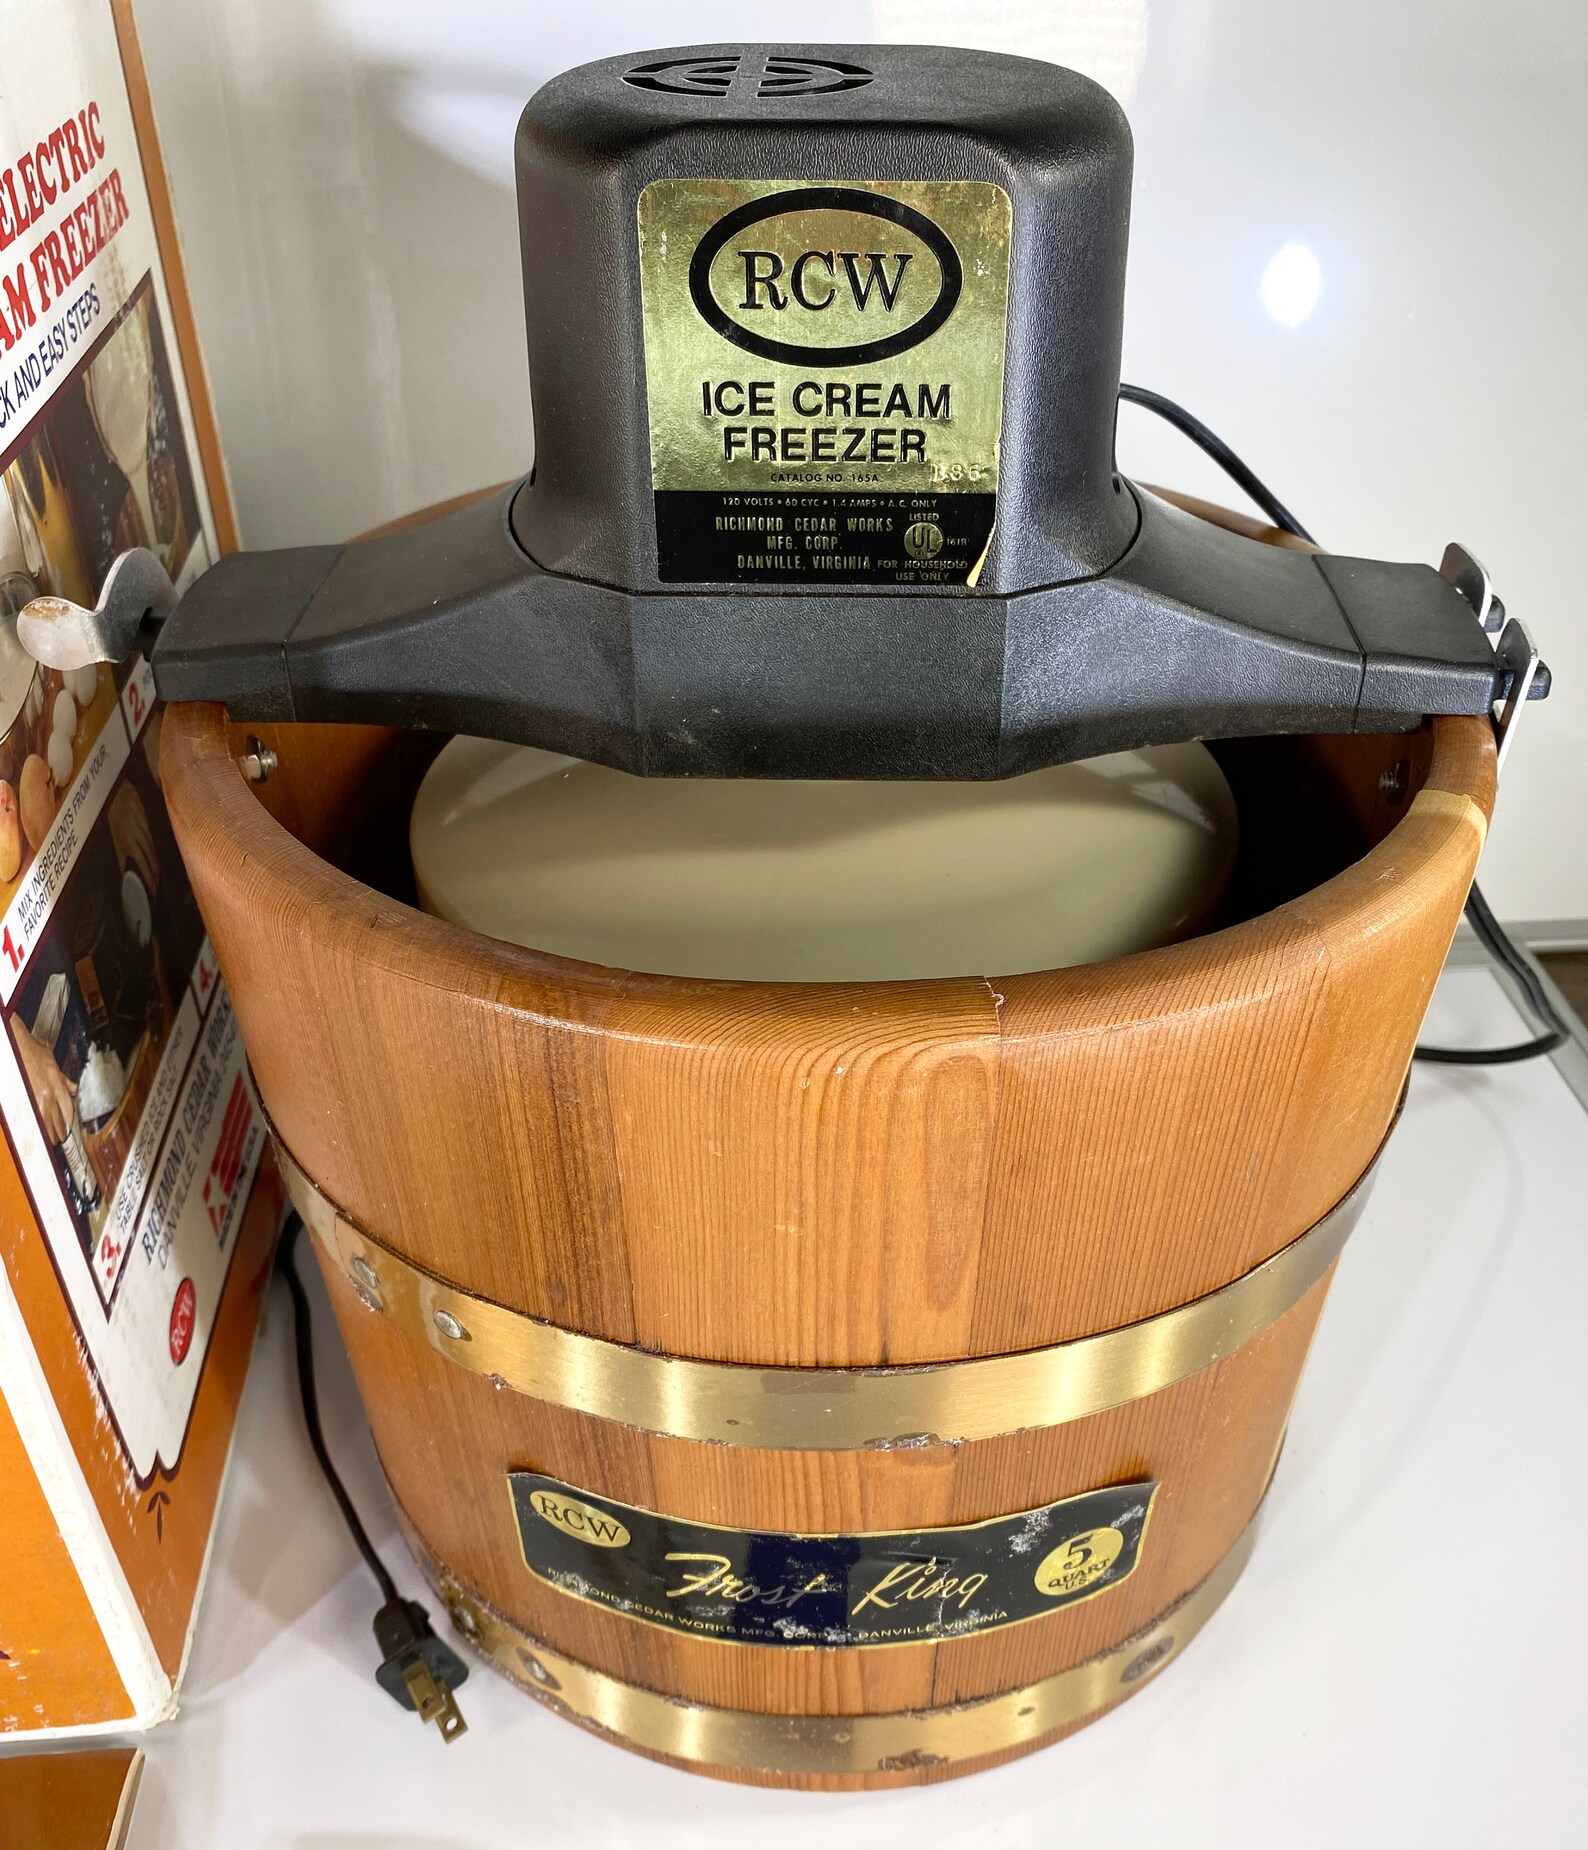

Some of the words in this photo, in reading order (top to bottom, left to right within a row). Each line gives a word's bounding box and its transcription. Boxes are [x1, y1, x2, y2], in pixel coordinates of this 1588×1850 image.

[30, 168, 130, 313] FREEZER
[738, 250, 914, 312] RCW
[14, 353, 41, 408] AND
[38, 317, 69, 377] EASY
[66, 282, 100, 343] STEPS
[702, 381, 776, 418] ICE
[792, 382, 952, 419] CREAM
[723, 428, 927, 462] FREEZER
[771, 473, 822, 482] CATALOG
[852, 474, 878, 482] 165A
[723, 497, 740, 506] 120
[744, 497, 774, 506] VOLTS
[785, 498, 798, 507] 60
[801, 498, 819, 507] CYC
[849, 499, 877, 508] AMPS
[911, 499, 938, 508] ONLY
[909, 513, 940, 521] LISTED
[715, 516, 784, 531] RICHMOND
[794, 517, 837, 532] CEDAR
[847, 517, 893, 532] WORKS
[766, 536, 798, 550] MFG.
[805, 536, 843, 550] CORP.
[737, 555, 806, 571] DANVILLE,
[812, 556, 871, 570] VIRGINIA
[878, 560, 898, 569] FOR
[904, 560, 968, 570] HOUSEHOLD
[896, 571, 915, 581] USE
[920, 571, 949, 581] ONLY
[18, 889, 32, 922] MIX
[32, 808, 74, 896] INGREDIENTS
[72, 777, 91, 815] FROM
[89, 744, 107, 780] YOUR
[24, 873, 56, 942] FAVORITE
[2, 925, 25, 973] 1.
[116, 1190, 128, 1221] USE
[125, 1121, 150, 1188] CRUSHED
[142, 1128, 185, 1265] RICHMOND
[158, 1153, 197, 1270] DANVILLE
[171, 1285, 193, 1356] RCW
[537, 1494, 621, 1542] RCW
[1063, 1533, 1093, 1570] 5
[665, 1553, 828, 1608] Frost
[852, 1556, 989, 1616] King
[1048, 1558, 1110, 1588] QUART
[625, 1600, 674, 1621] CEDAR
[677, 1615, 736, 1633] WORKS
